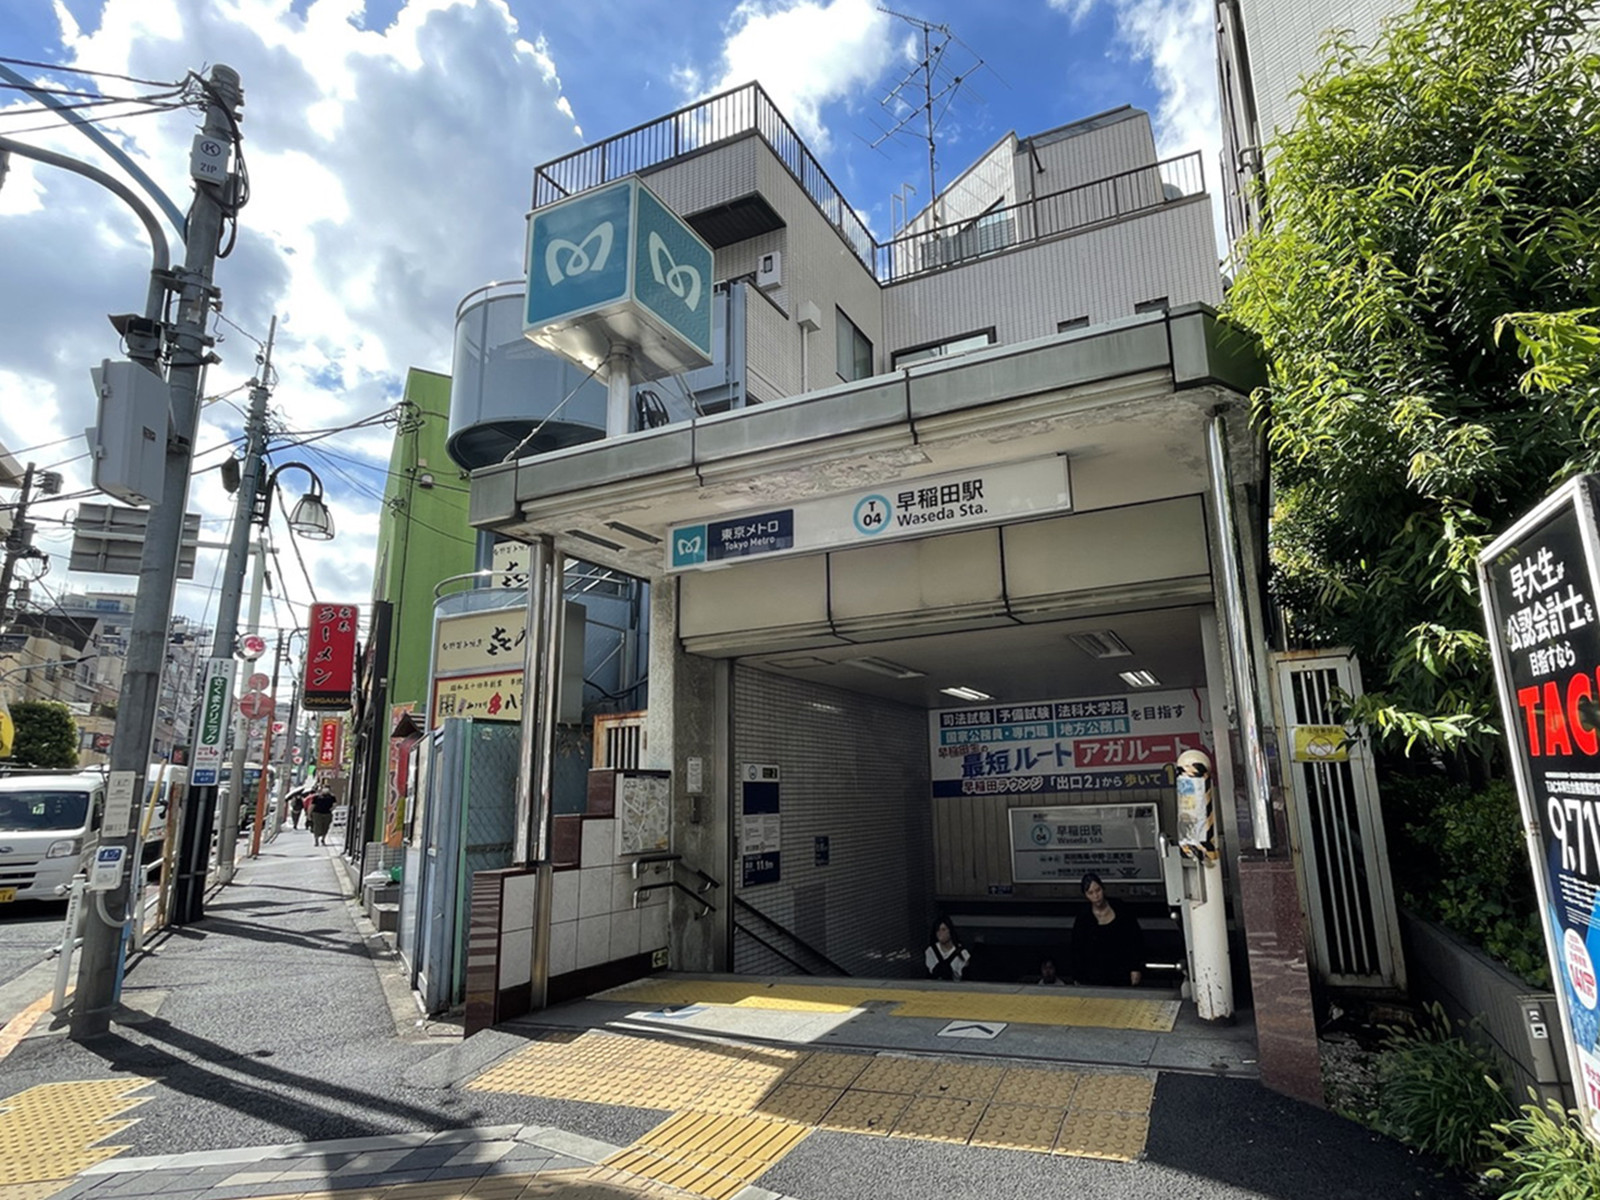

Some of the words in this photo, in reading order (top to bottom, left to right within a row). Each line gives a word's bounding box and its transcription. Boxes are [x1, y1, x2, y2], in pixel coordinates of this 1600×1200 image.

[868, 501, 876, 512] T
[896, 479, 984, 512] 早稲田駅
[863, 513, 882, 526] 04
[897, 507, 955, 527] Waseda
[959, 503, 988, 517] Sta.
[721, 520, 779, 541] 東京メトロ
[724, 540, 748, 552] Tokyo
[749, 536, 776, 547] Metro
[1507, 584, 1594, 653] 公認会計士を
[312, 606, 337, 686] ラーメン
[1528, 640, 1576, 677] 目指すなら
[943, 711, 992, 726] 司法試験
[1000, 706, 1050, 722] 予備試験
[1058, 700, 1126, 717] 法科大学院
[1131, 704, 1185, 721] を目指す
[1518, 665, 1600, 757] TAC
[1060, 719, 1127, 736] 地方公務員
[961, 742, 1072, 778] 最短ルート
[1080, 737, 1191, 764] アガルート
[962, 776, 1044, 794] 早稲田ラウンジ
